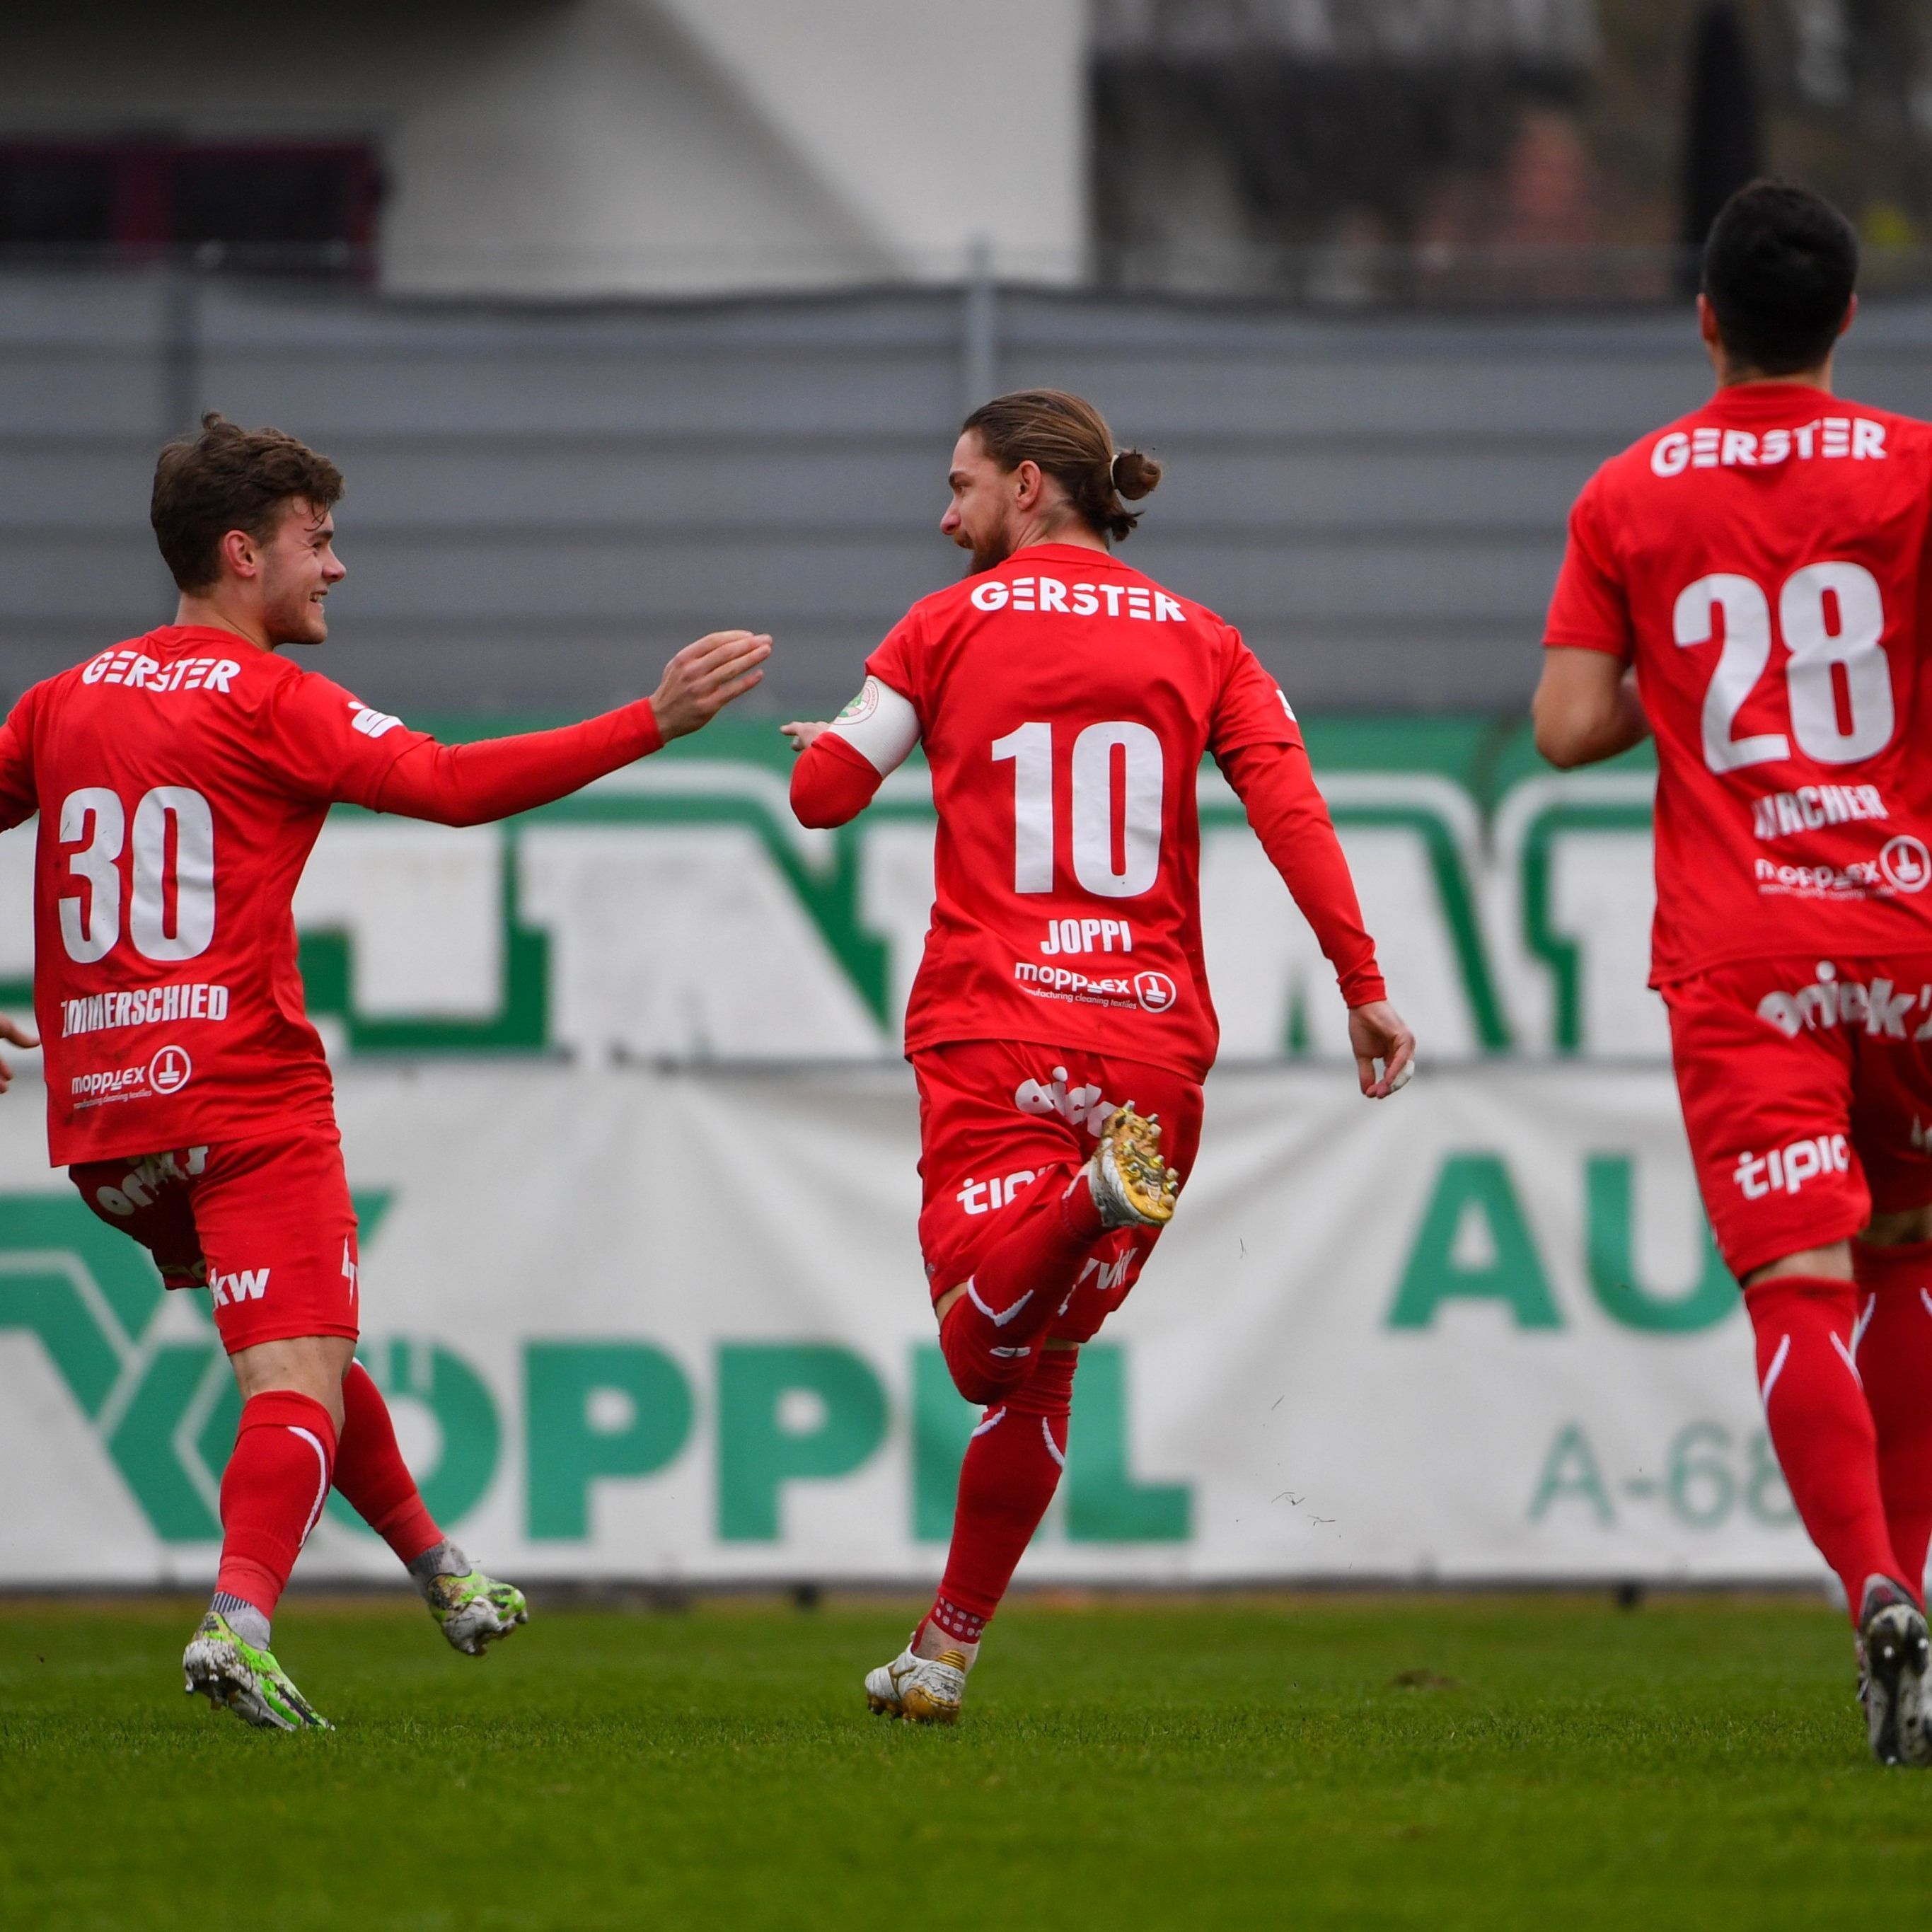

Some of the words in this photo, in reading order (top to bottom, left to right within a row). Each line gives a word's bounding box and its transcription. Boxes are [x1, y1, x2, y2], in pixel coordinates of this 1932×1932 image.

[1650, 417, 1887, 478] GERSTER
[971, 577, 1186, 622] GERSTER
[81, 650, 241, 693] GERSTER
[1673, 561, 1895, 773] 28
[991, 721, 1164, 898] 10
[59, 785, 216, 964] 30
[1040, 919, 1132, 955] JOPPI
[1075, 993, 1109, 1007] cleaning
[1110, 999, 1137, 1010] textiles
